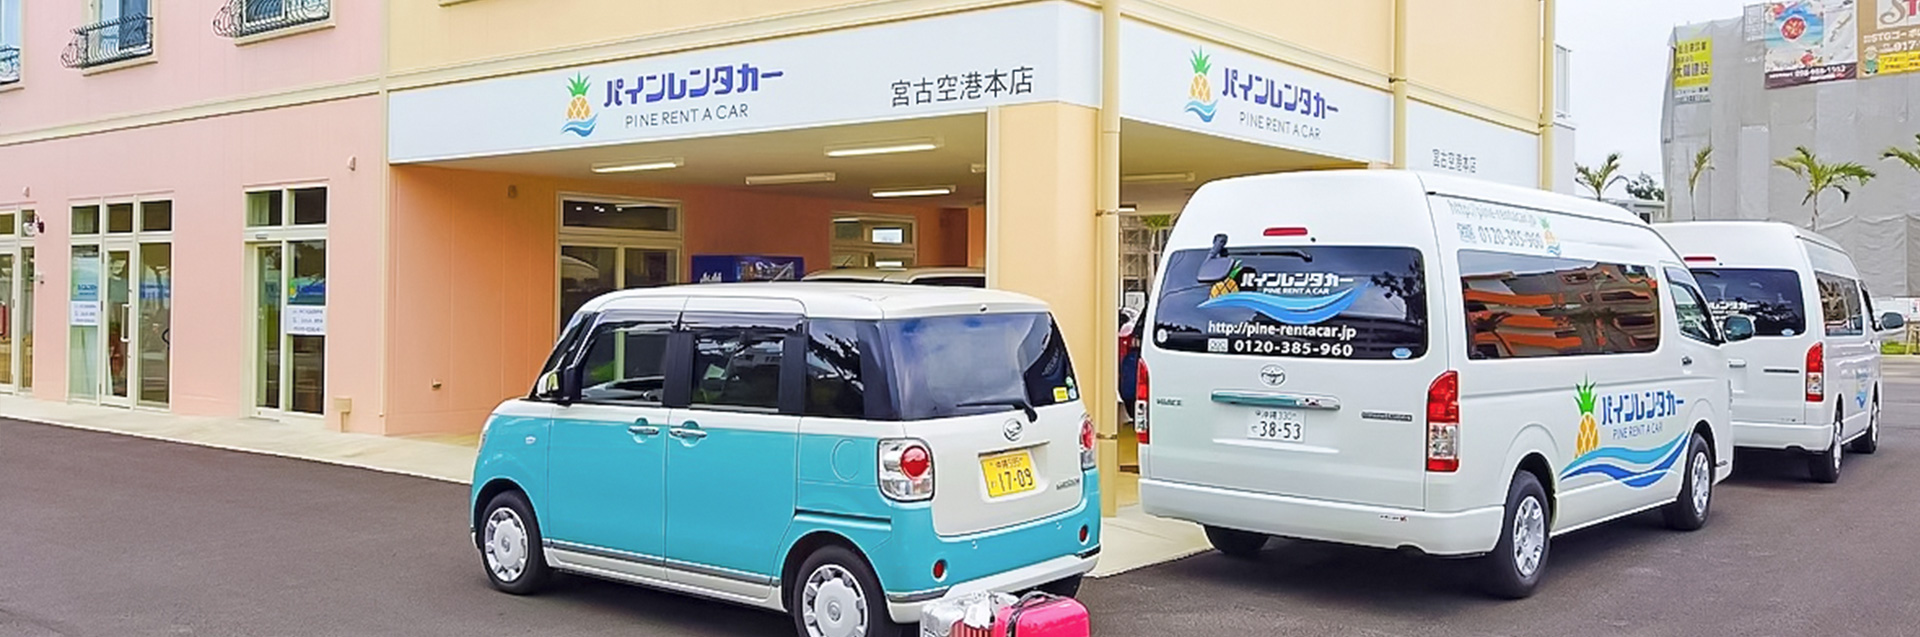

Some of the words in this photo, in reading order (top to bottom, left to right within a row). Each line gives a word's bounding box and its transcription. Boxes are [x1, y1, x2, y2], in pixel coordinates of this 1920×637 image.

[603, 63, 784, 108] パインレンタカー
[891, 66, 1034, 107] 宮古空港本店
[1222, 67, 1339, 119] パインレンタカー
[625, 113, 658, 128] PINE
[662, 108, 699, 125] RENT
[702, 107, 713, 121] A
[716, 103, 749, 120] CAR
[1239, 111, 1264, 129] PINE
[1266, 117, 1291, 135] RENT
[1292, 124, 1301, 136] A
[1302, 124, 1321, 140] CAR
[1432, 148, 1477, 174] 宮古空港本店
[1240, 272, 1354, 287] パインレンタカー
[1305, 287, 1312, 295] A
[1312, 287, 1330, 295] CAR
[1207, 320, 1357, 341] http://pine-rentacar.jp
[1234, 339, 1354, 357] 0120-385-960
[1602, 390, 1684, 425] パインレンタカー
[1612, 427, 1628, 440] PINE
